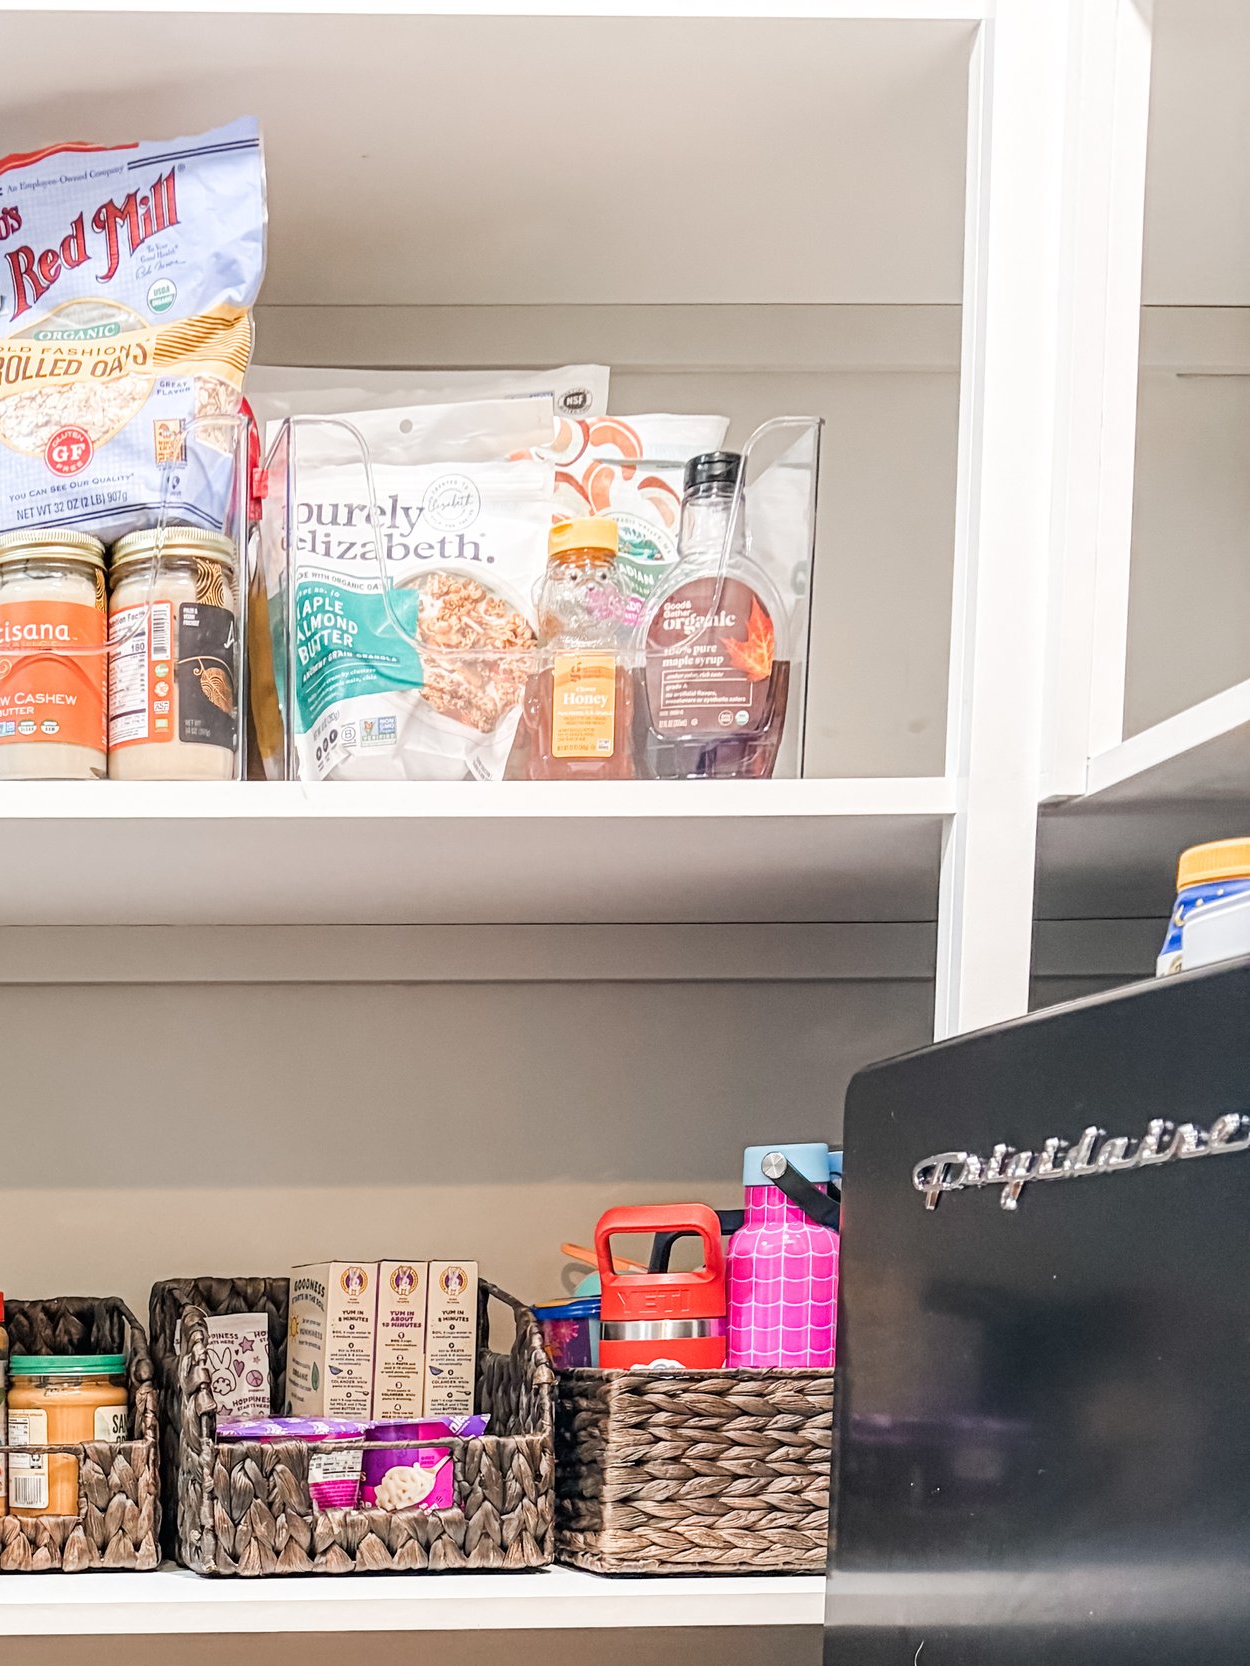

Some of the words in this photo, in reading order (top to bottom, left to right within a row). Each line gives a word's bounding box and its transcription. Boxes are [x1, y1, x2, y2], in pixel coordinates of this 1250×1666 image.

[89, 165, 124, 180] Company
[4, 211, 92, 322] Red
[91, 166, 180, 284] Mill
[39, 324, 116, 341] ORGANIC
[156, 386, 191, 396] FLAVOR
[159, 380, 187, 388] GREAT
[565, 394, 585, 406] NSF
[52, 443, 86, 462] GF
[56, 460, 85, 473] FREE
[9, 493, 27, 502] YOU
[29, 488, 48, 498] CAN
[50, 483, 67, 493] SEE
[69, 480, 89, 489] OUR
[92, 474, 132, 485] QUALITY
[17, 508, 34, 521] NET
[36, 504, 53, 517] WT
[54, 501, 65, 513] 32
[66, 498, 79, 511] OZ
[311, 572, 330, 581] WITH
[331, 575, 365, 591] ORGANIC
[296, 596, 345, 616] APLE
[662, 610, 736, 635] organic
[131, 642, 145, 652] 180
[298, 629, 354, 667] BUTTER
[693, 644, 718, 656] pure
[356, 653, 398, 663] GRANOLA
[662, 655, 694, 668] maple
[694, 655, 724, 667] syrup
[13, 691, 78, 705] CASHEW
[563, 692, 608, 708] Honey
[913, 1112, 1250, 1211] Frigidaire
[293, 1279, 326, 1299] GOODNESS
[616, 1289, 691, 1315] YETI
[343, 1315, 369, 1323] MINUTES
[443, 1315, 469, 1323] MINUTES
